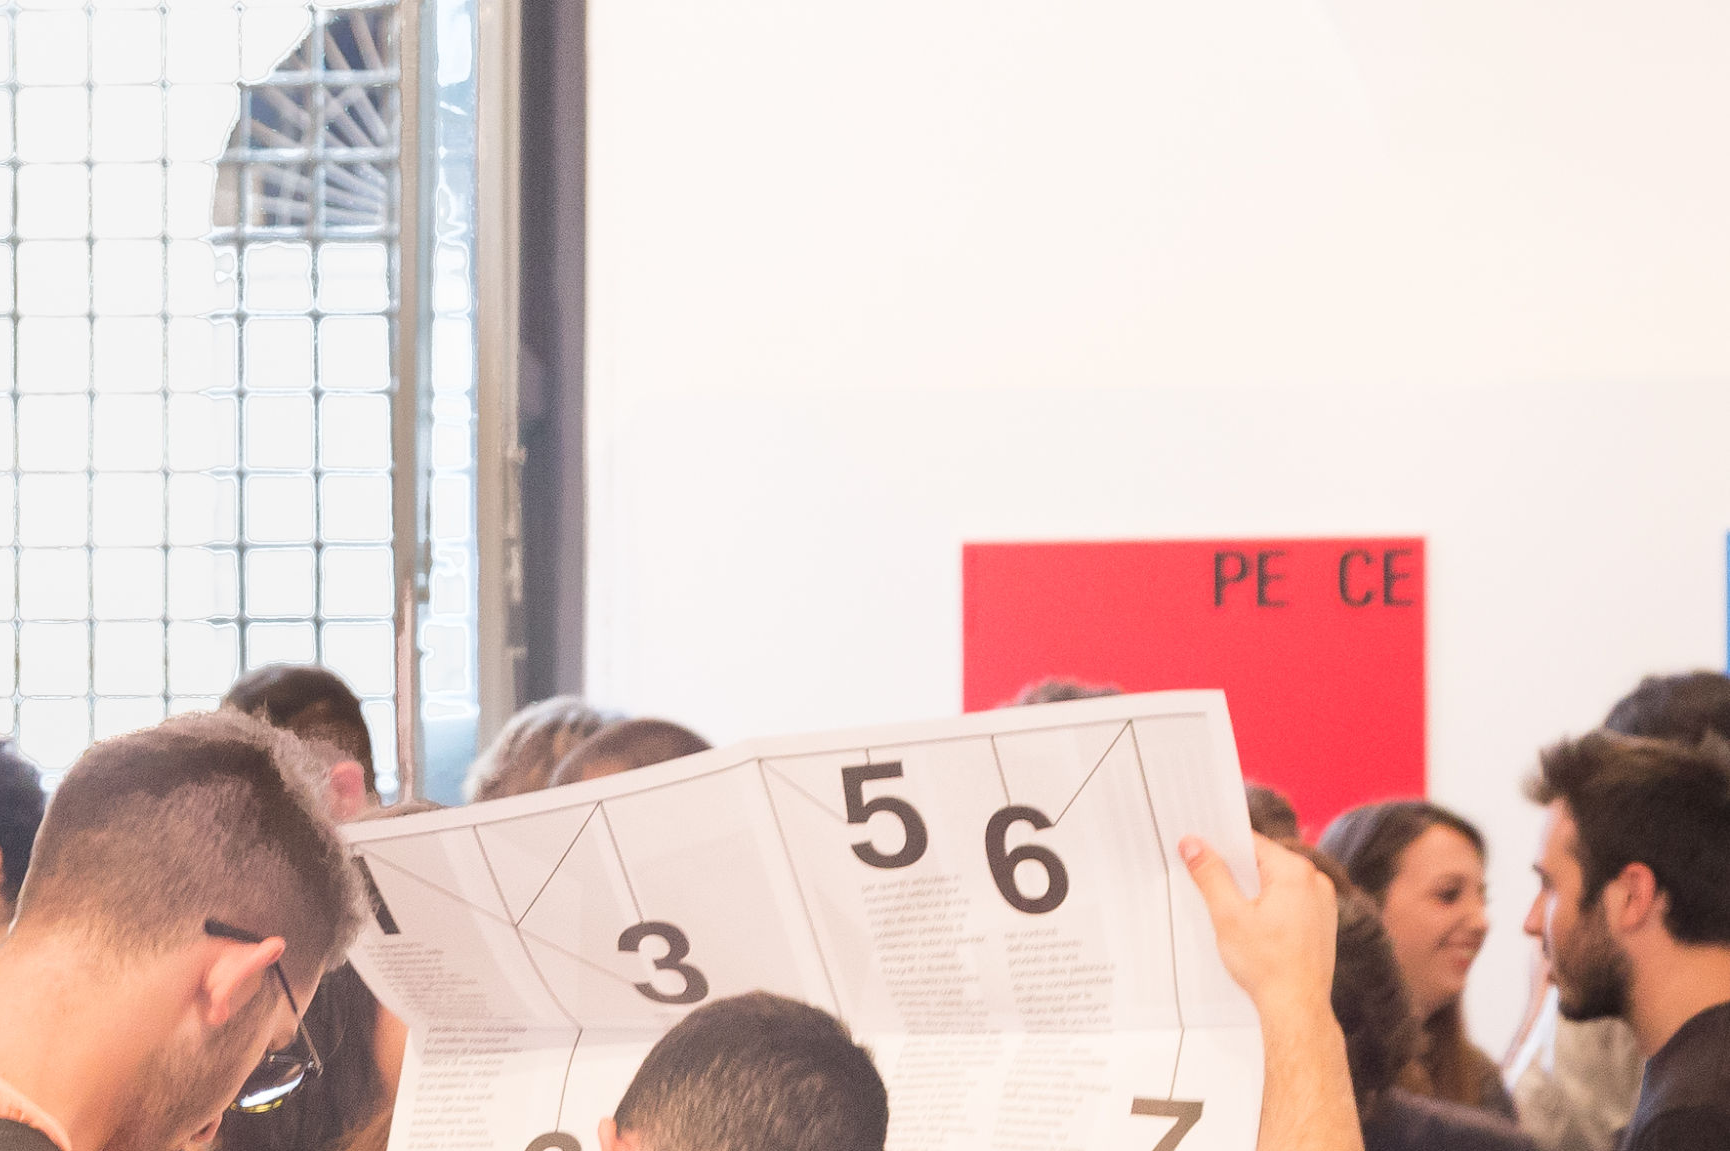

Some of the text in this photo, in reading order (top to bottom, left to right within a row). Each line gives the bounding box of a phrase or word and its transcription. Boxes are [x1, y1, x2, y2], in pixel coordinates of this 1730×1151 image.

[1212, 547, 1413, 608] PE CE
[841, 759, 929, 869] 5
[984, 804, 1070, 914] 6
[617, 920, 710, 1005] 3
